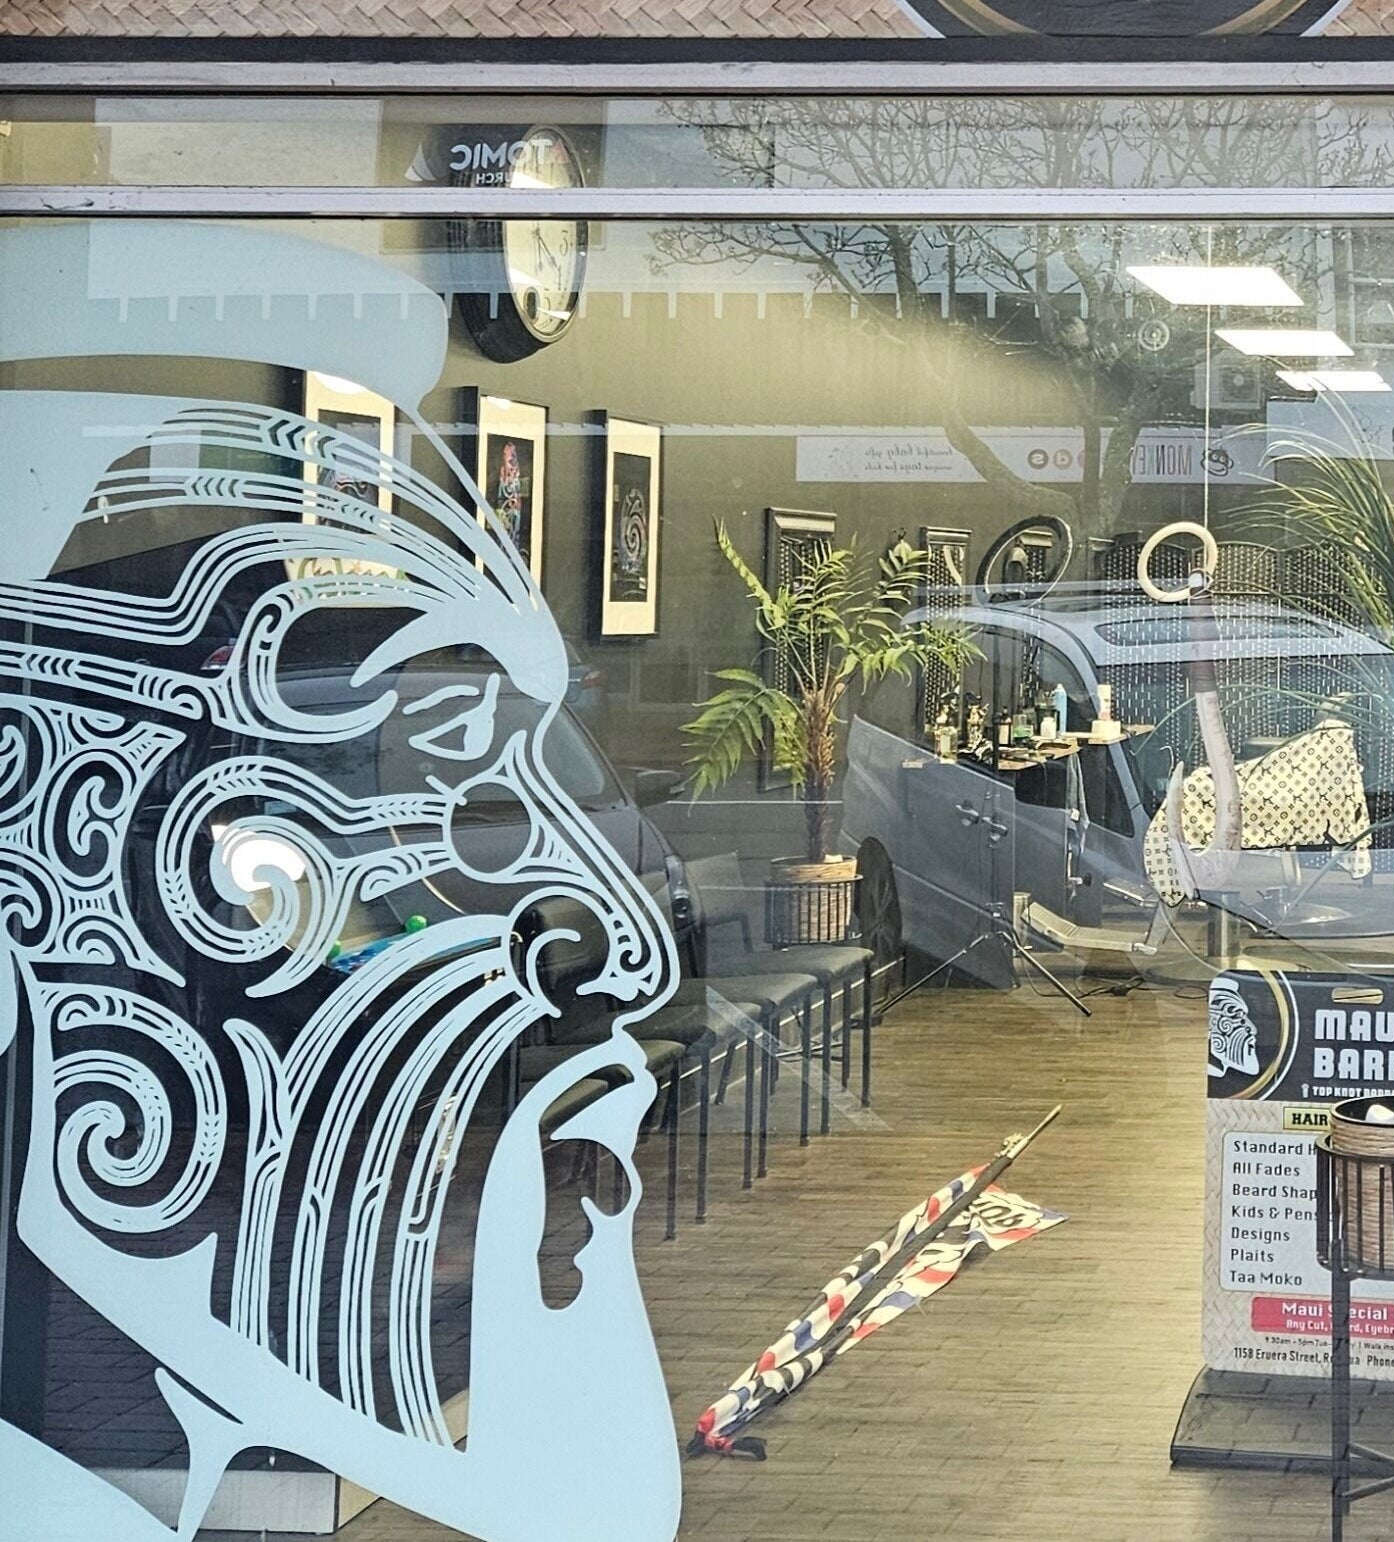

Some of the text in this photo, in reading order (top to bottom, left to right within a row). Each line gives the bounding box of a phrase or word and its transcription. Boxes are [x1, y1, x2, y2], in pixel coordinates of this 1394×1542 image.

[1312, 1086, 1332, 1097] TOP
[1334, 1086, 1362, 1098] KNOT
[1292, 1113, 1329, 1126] HAIR
[1234, 1140, 1303, 1156] Standard
[1233, 1162, 1301, 1177] All Fades
[1232, 1183, 1317, 1202] Beard Shap
[1231, 1205, 1264, 1219] Kids
[1269, 1207, 1280, 1219] &
[1231, 1226, 1291, 1245] Designs
[1230, 1248, 1275, 1263] Plaits
[1230, 1270, 1303, 1287] Taa Moko
[1281, 1302, 1323, 1318] Maui
[1328, 1305, 1388, 1321] Secial
[1286, 1319, 1306, 1332] Any
[1307, 1320, 1329, 1332] Cut,
[1233, 1347, 1254, 1360] 1158
[1255, 1348, 1288, 1362] Eruera
[1289, 1350, 1322, 1364] Street,
